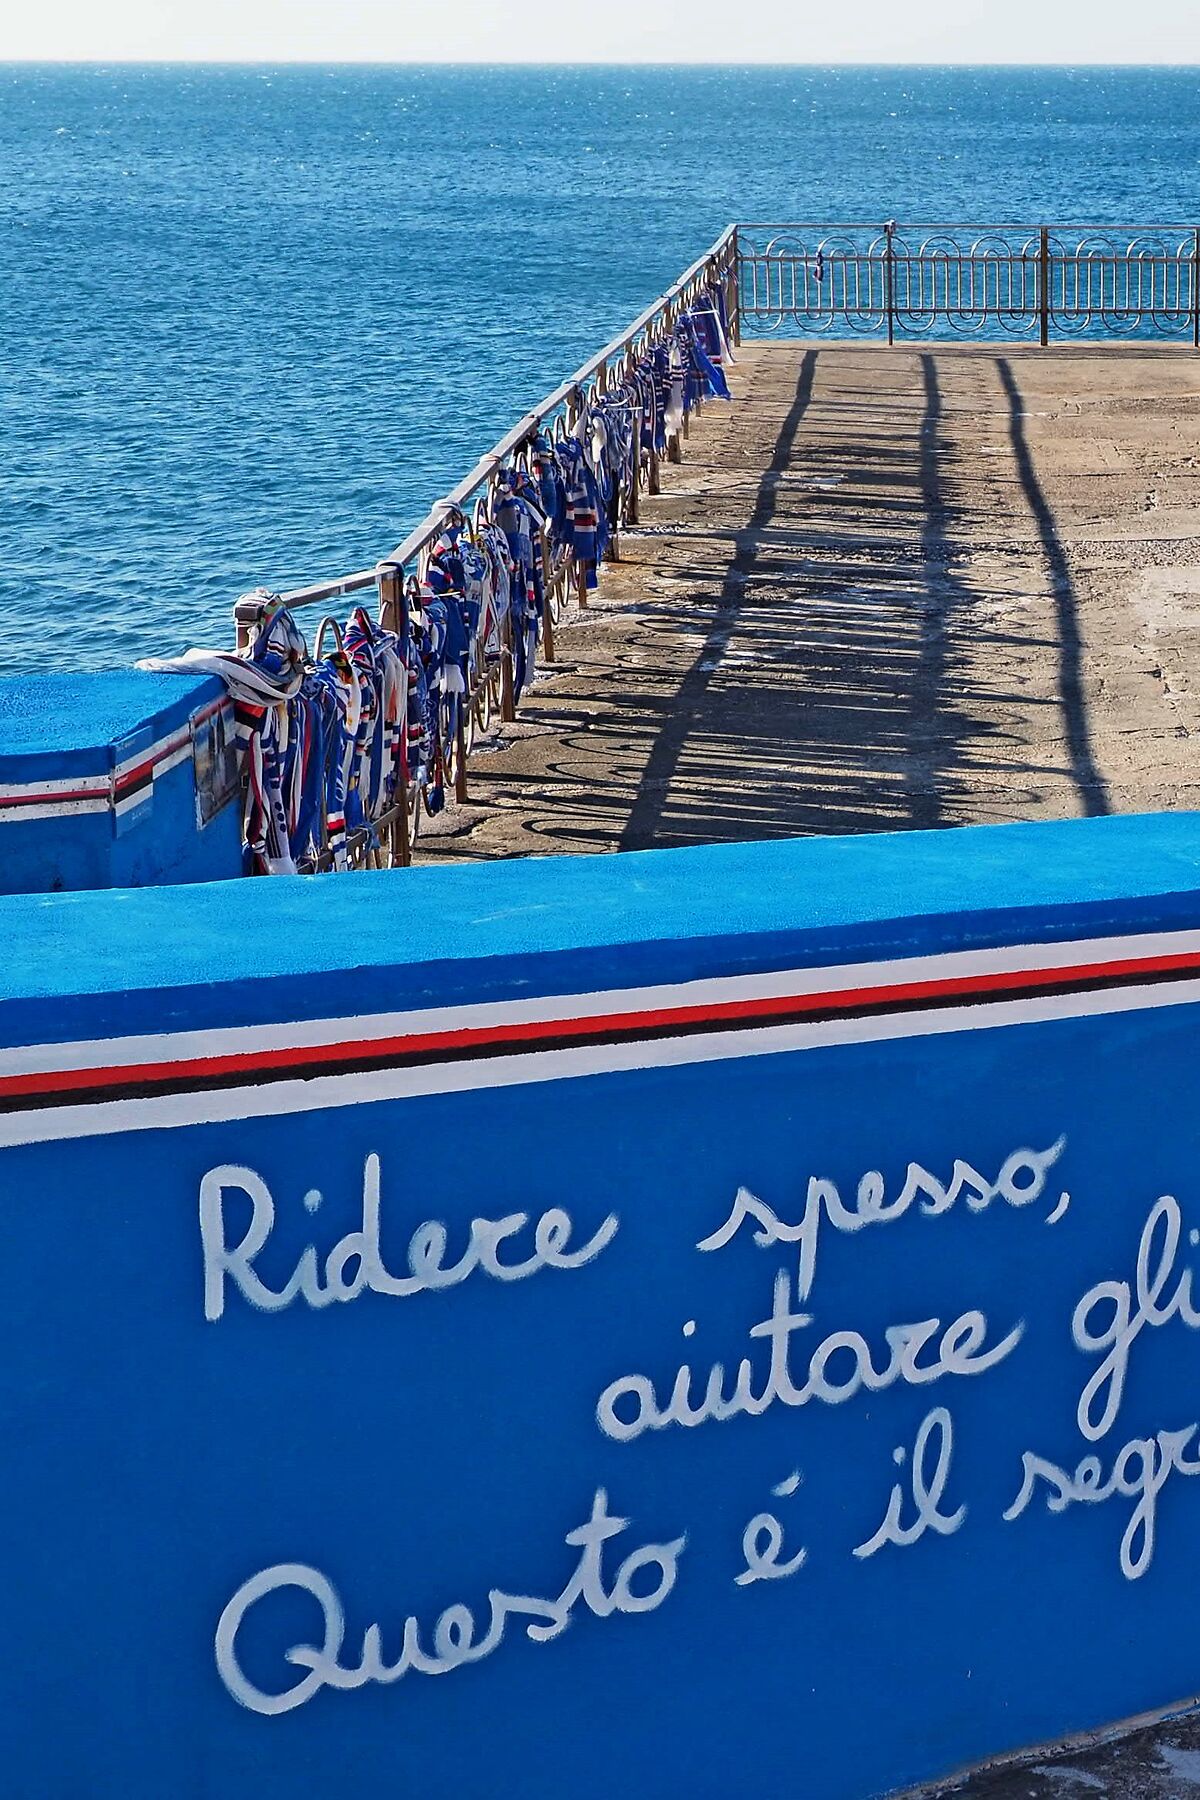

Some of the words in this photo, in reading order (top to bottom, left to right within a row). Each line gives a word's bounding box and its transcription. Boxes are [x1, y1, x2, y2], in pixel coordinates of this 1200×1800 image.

[199, 1152, 619, 1321] Ridere
[696, 1134, 1071, 1301] spesso,
[597, 1269, 1024, 1442] aiutare
[214, 1487, 687, 1715] Questo
[852, 1407, 966, 1558] il
